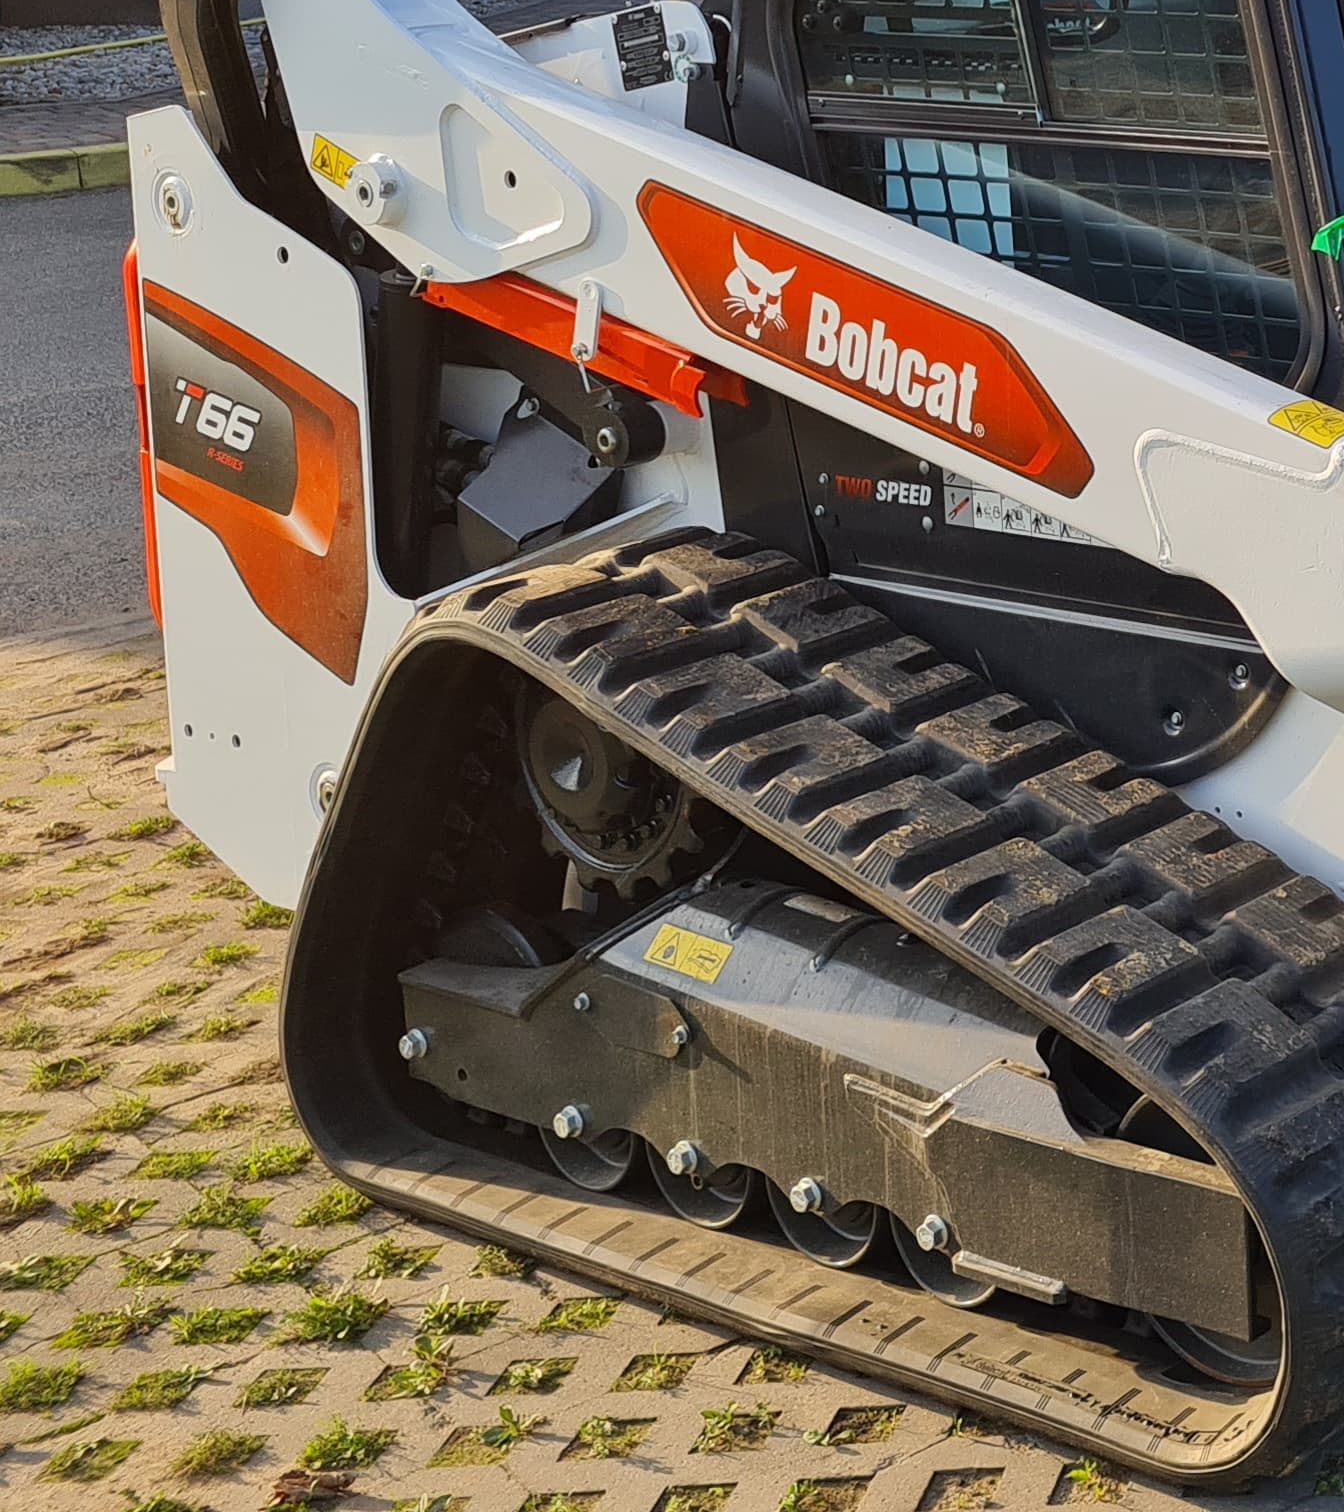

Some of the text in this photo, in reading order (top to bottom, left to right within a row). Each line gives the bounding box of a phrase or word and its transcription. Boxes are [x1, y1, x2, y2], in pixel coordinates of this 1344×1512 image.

[805, 291, 978, 434] Bobcat
[175, 376, 262, 452] T66
[207, 447, 246, 472] R-SERIES
[835, 475, 932, 507] TWO SPEED
